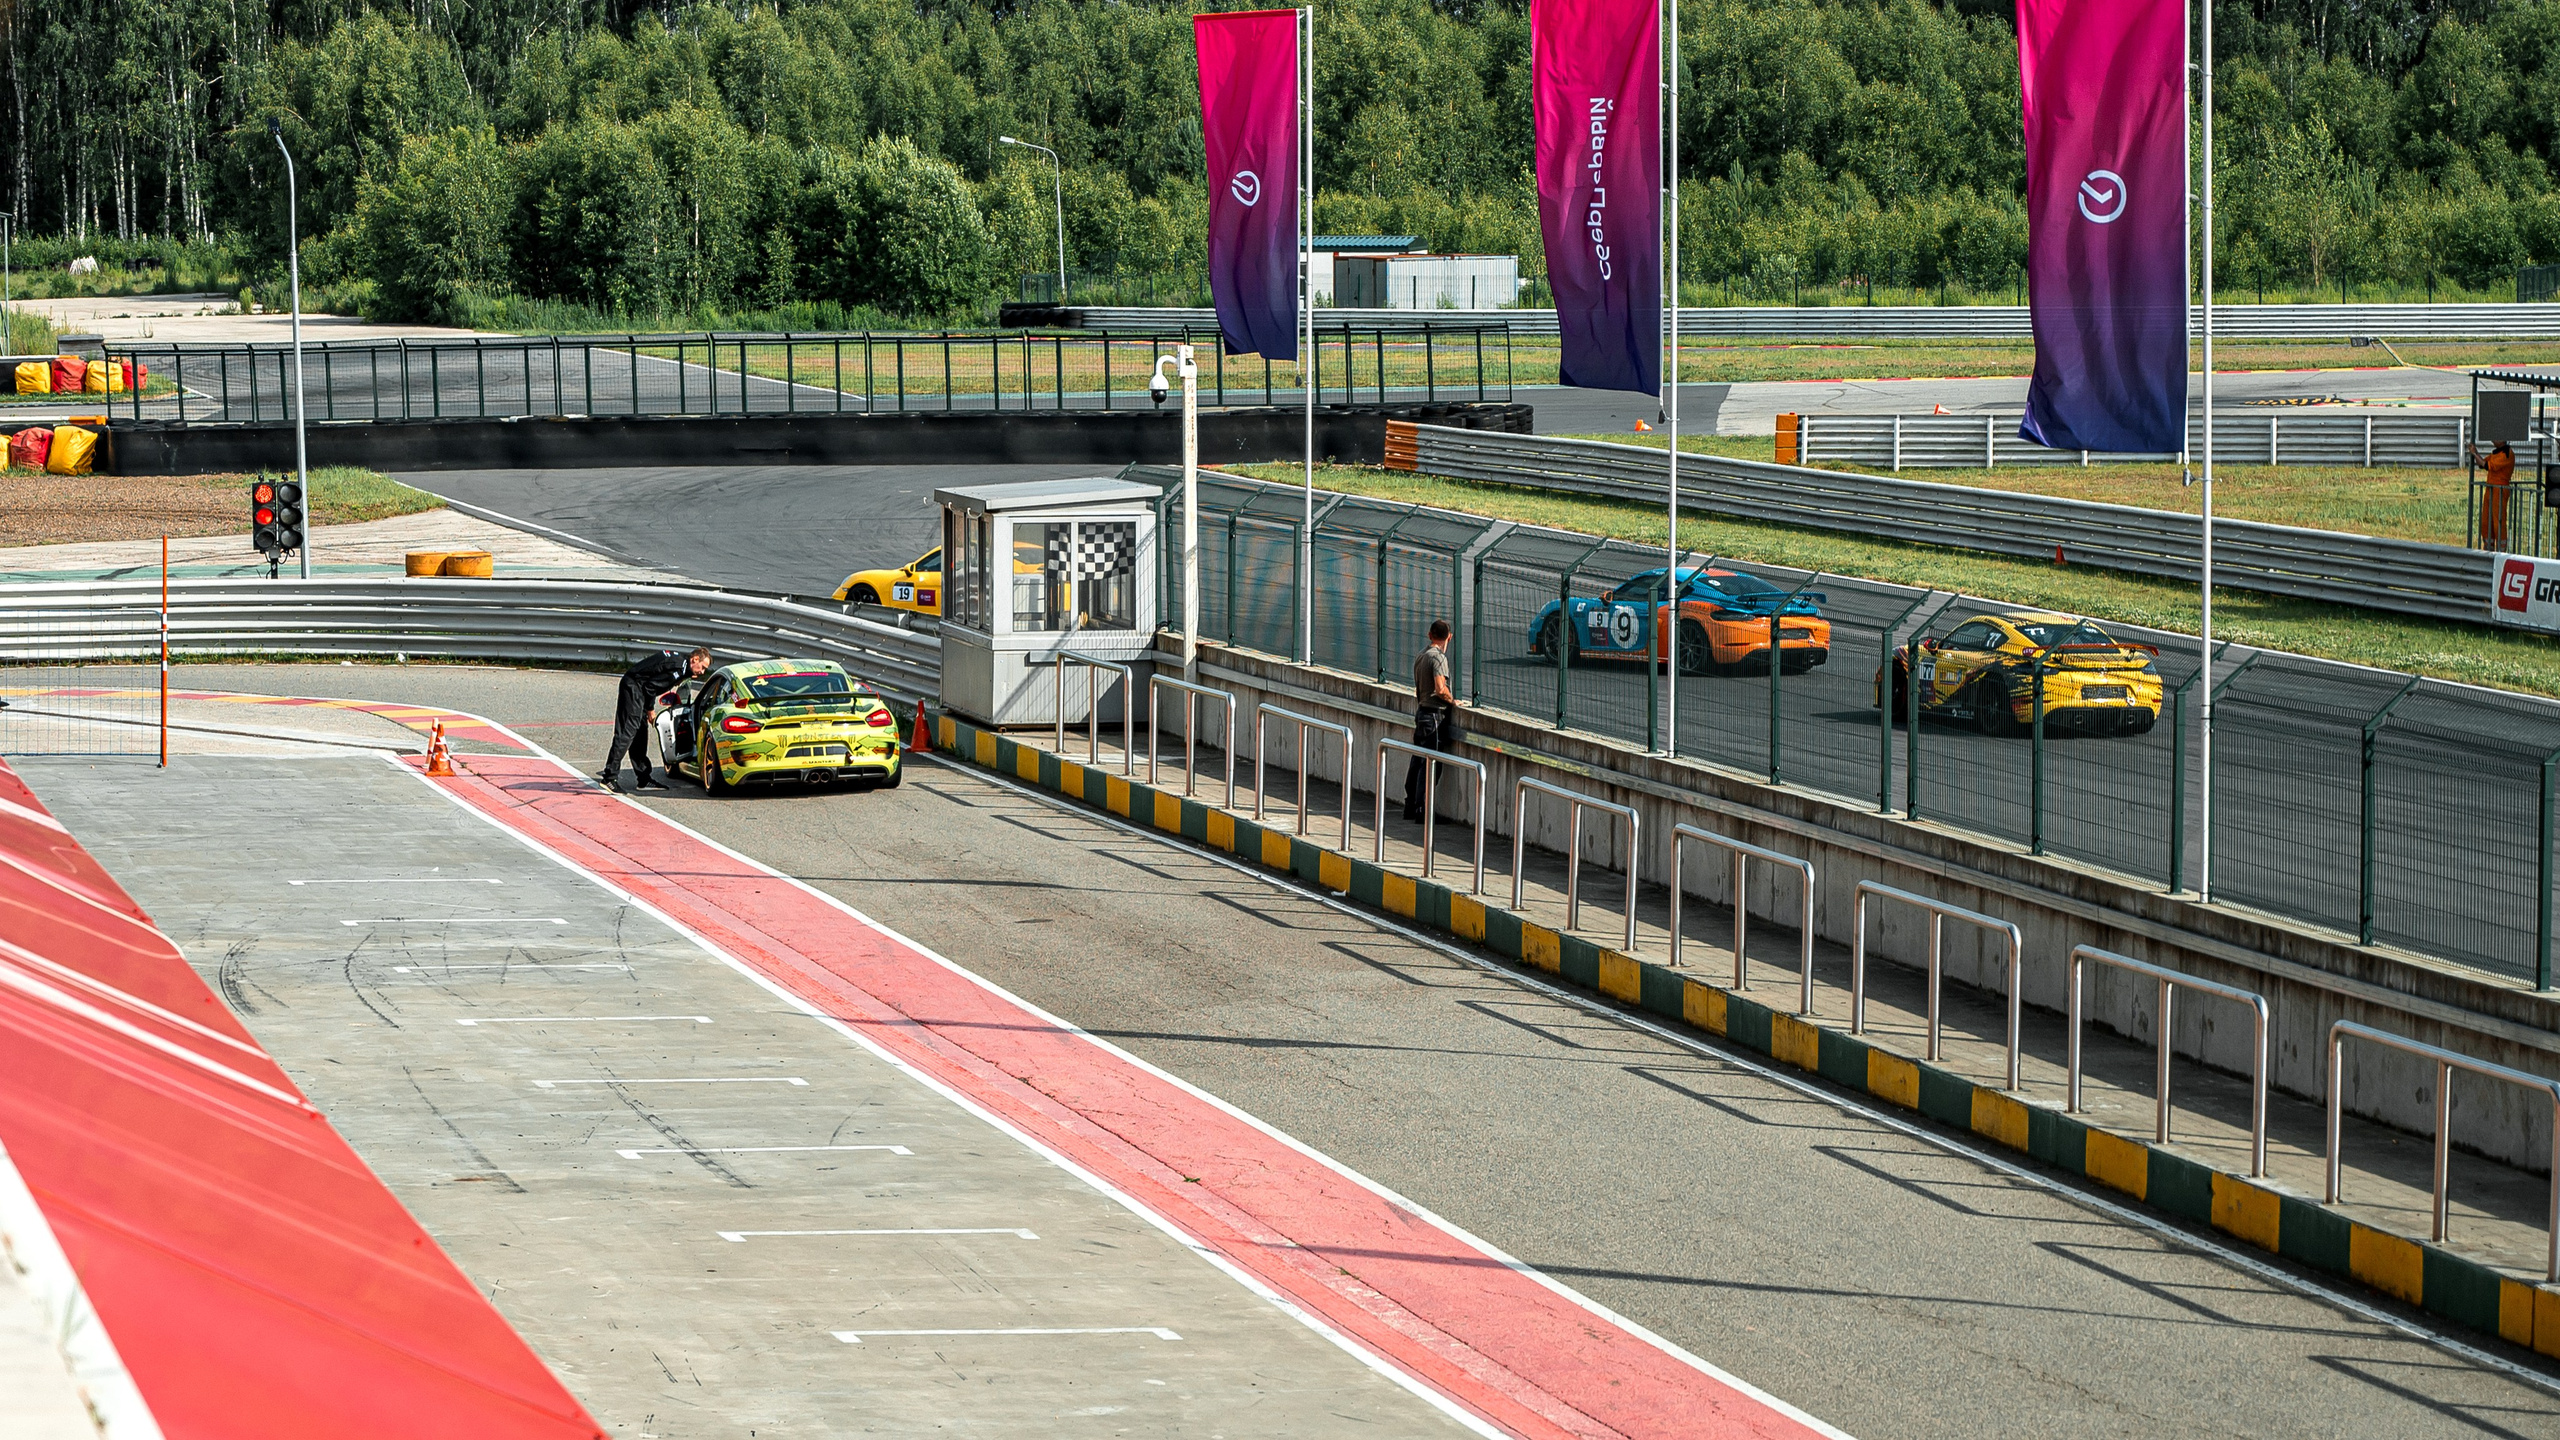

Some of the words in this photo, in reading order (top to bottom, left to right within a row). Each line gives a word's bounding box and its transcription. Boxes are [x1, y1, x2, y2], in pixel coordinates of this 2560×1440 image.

[899, 587, 910, 600] 19
[1596, 613, 1603, 627] 9
[1618, 612, 1631, 642] 9
[1986, 632, 2002, 648] 77
[1922, 663, 1934, 679] 77
[752, 678, 769, 686] 4
